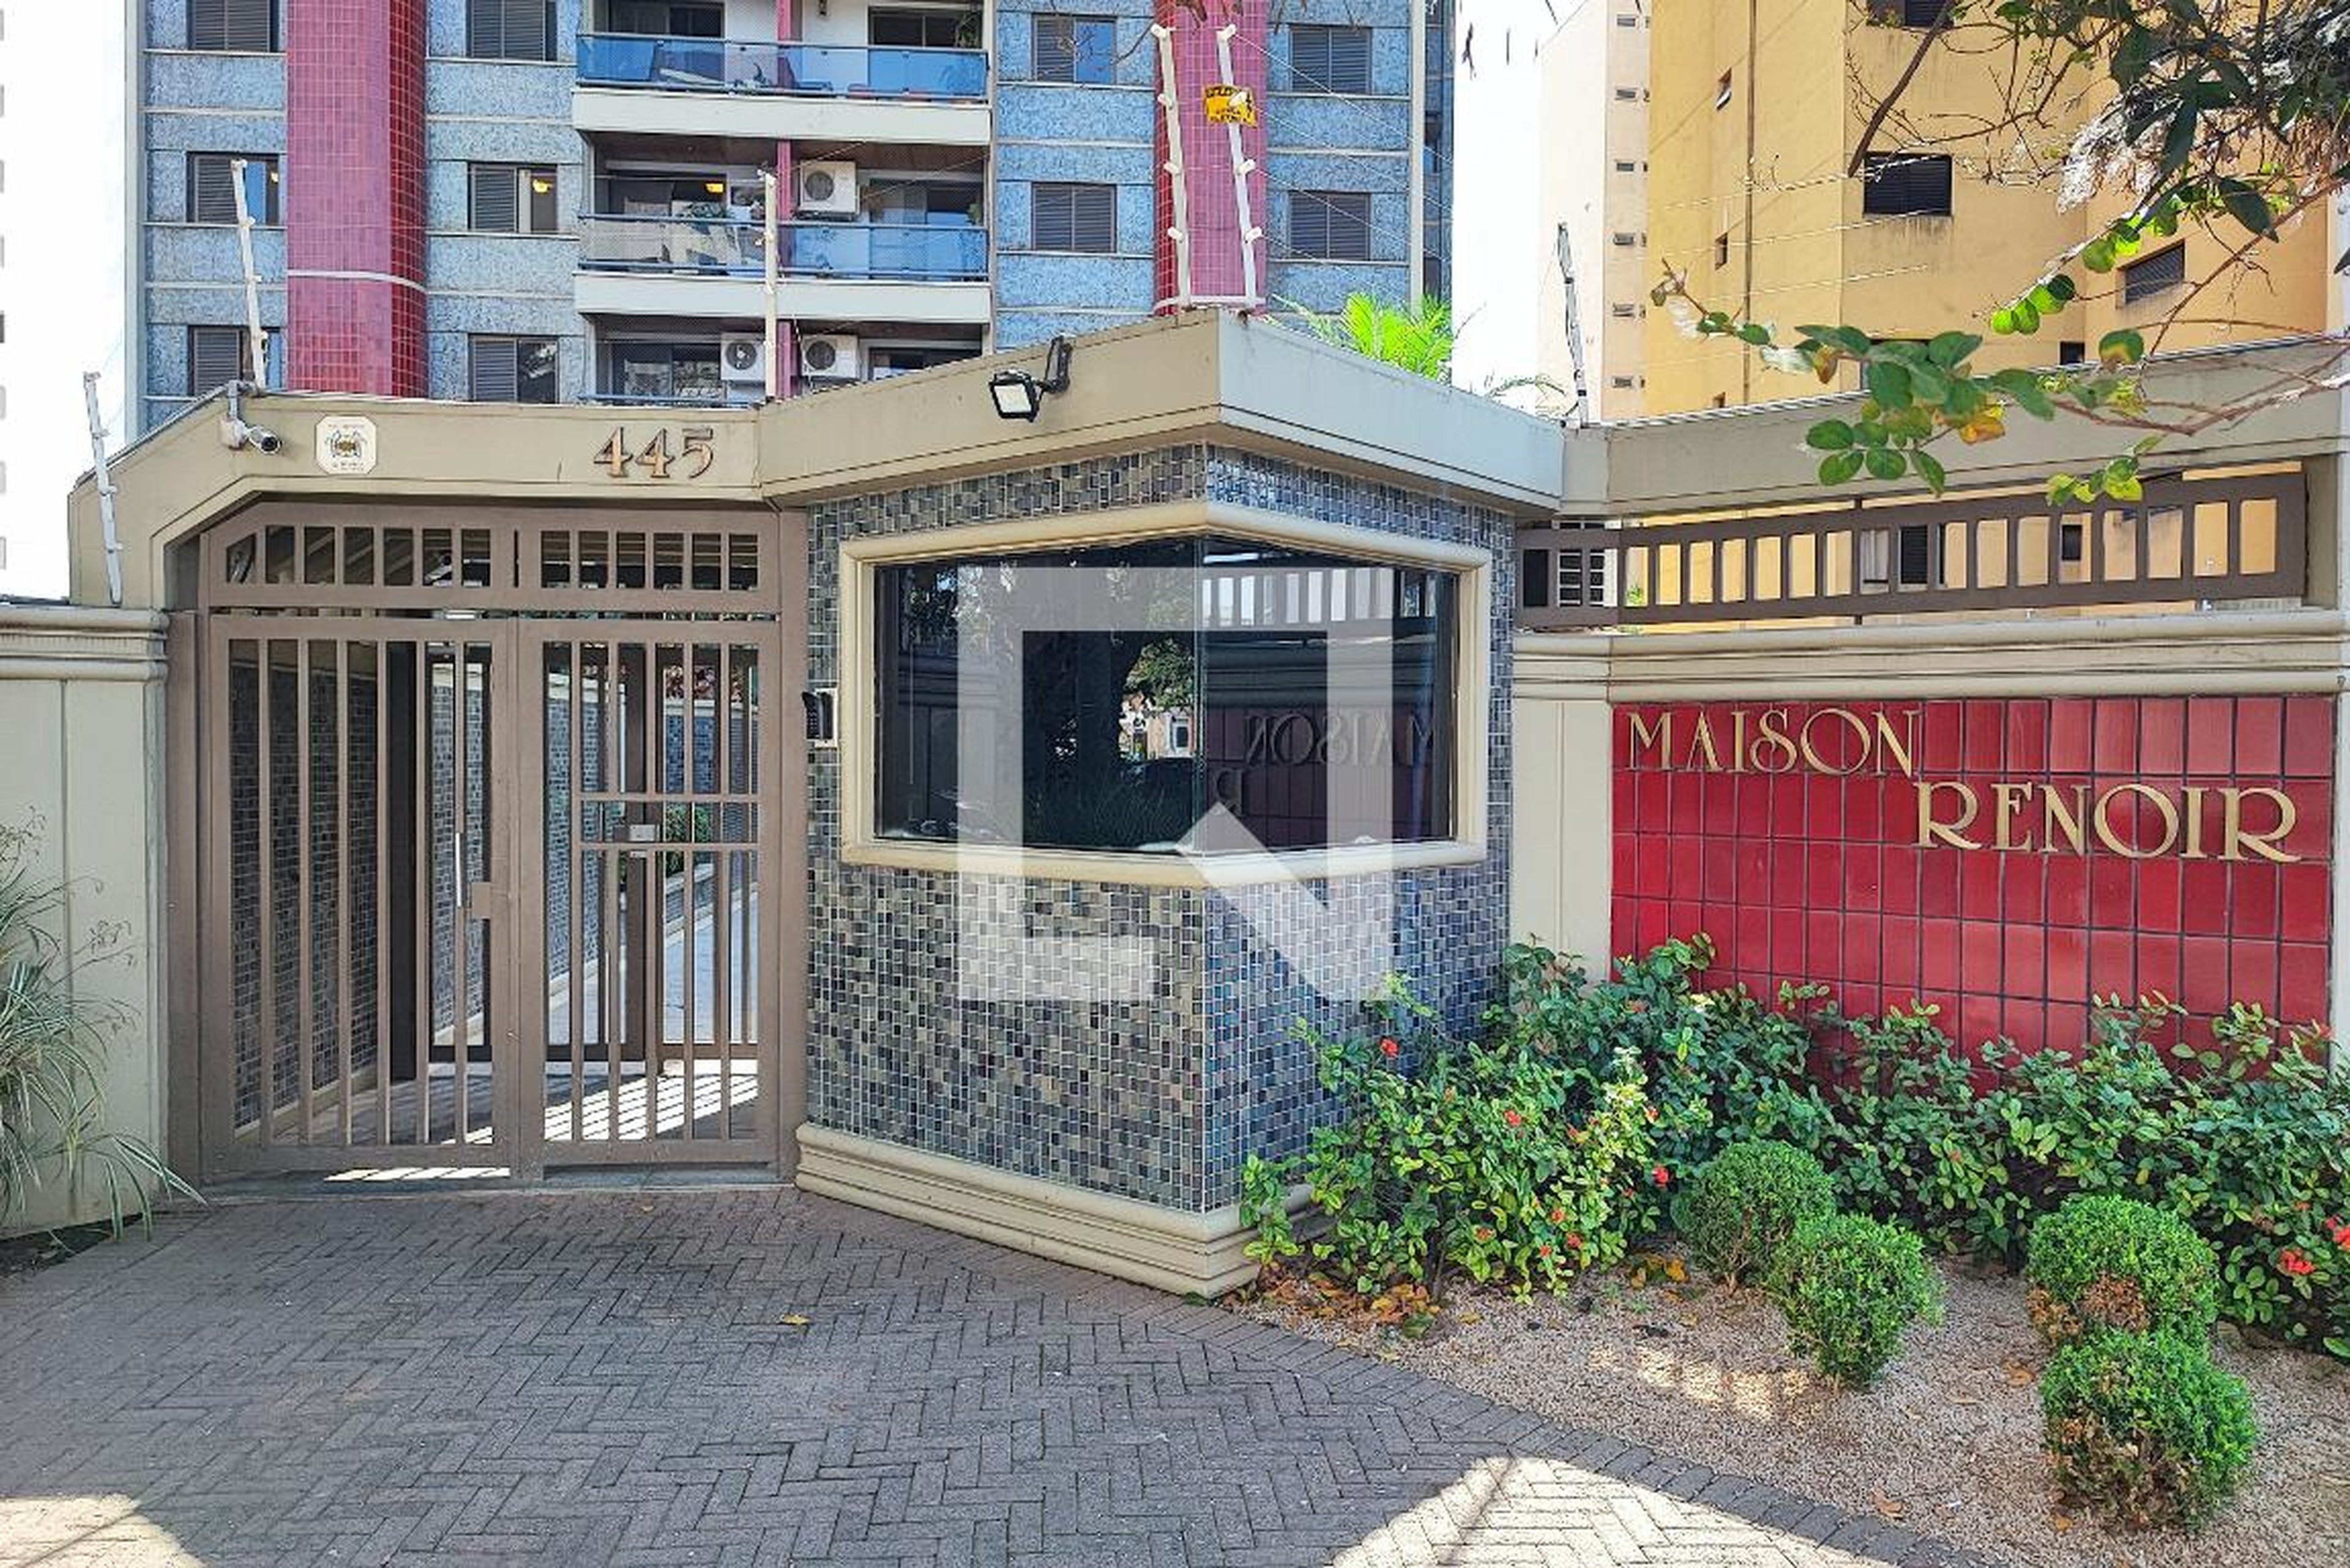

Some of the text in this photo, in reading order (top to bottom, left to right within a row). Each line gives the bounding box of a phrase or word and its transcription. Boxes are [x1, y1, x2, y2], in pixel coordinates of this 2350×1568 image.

[594, 427, 714, 479] 445
[1627, 707, 1921, 778] MAISON
[1913, 782, 2301, 862] RENOIR
